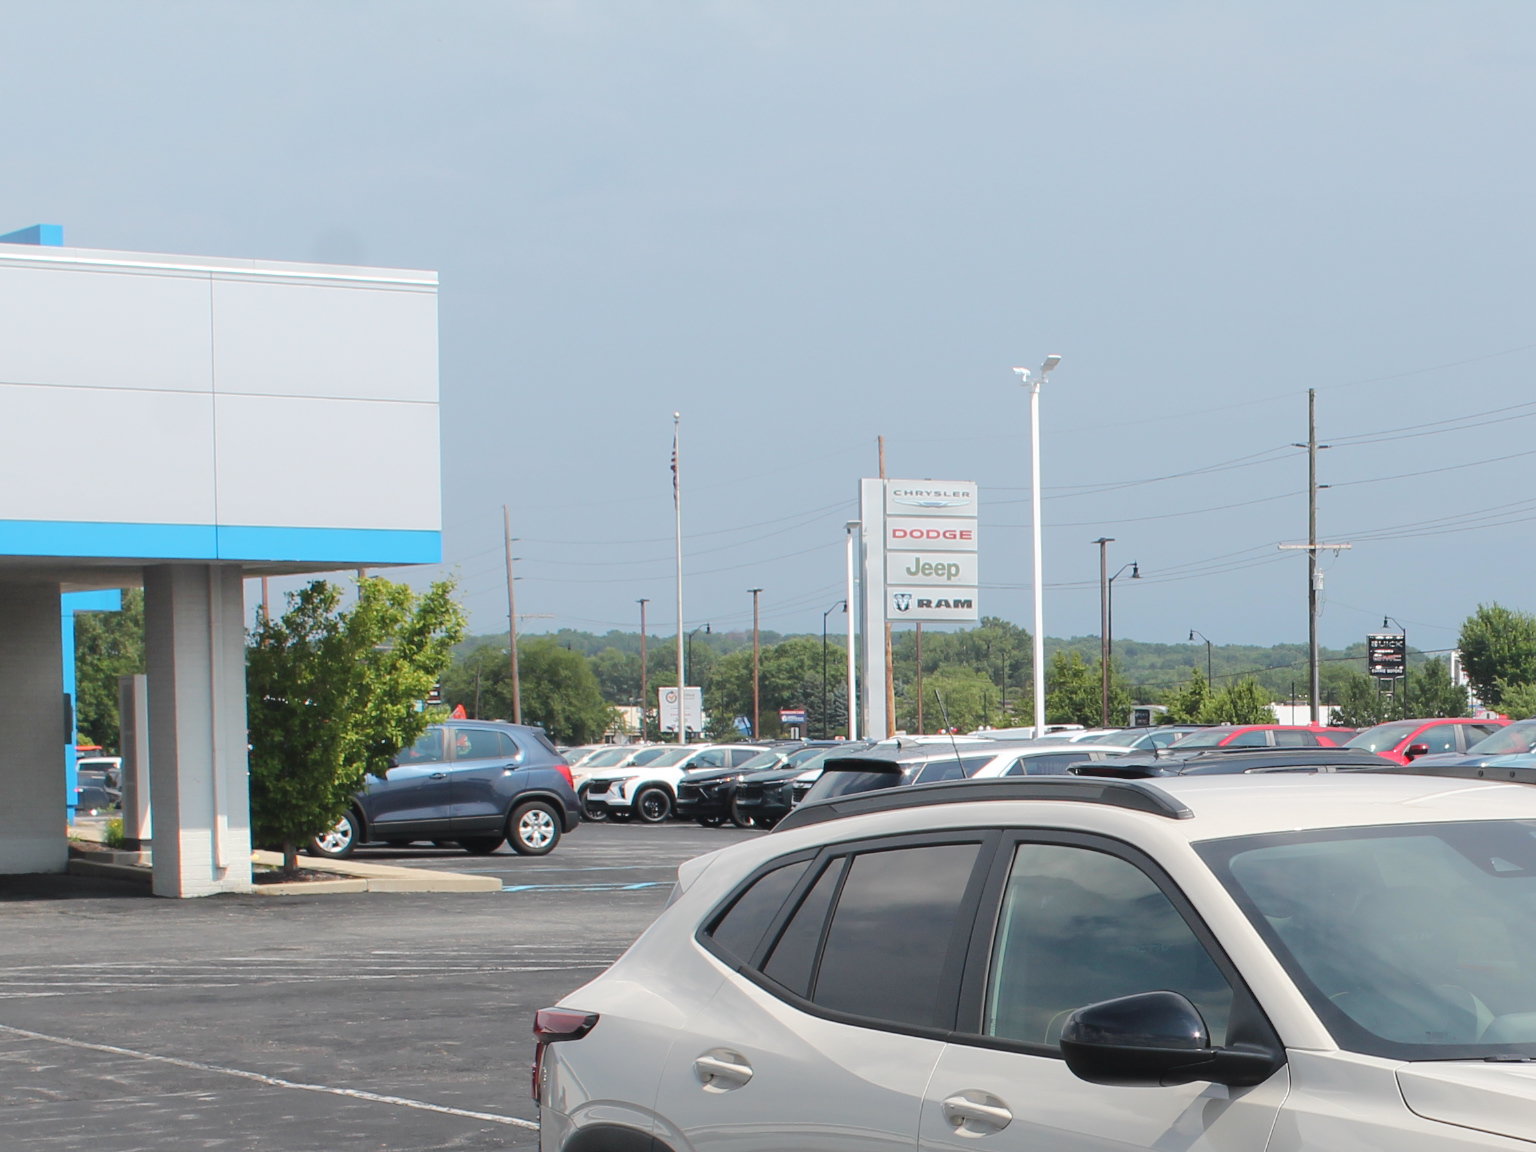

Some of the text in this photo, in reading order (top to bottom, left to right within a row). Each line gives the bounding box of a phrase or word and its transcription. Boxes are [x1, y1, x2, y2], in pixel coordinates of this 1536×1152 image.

[893, 489, 970, 498] CHRYSLER
[892, 528, 973, 540] DODGE
[905, 557, 960, 581] Jeep
[917, 598, 973, 609] RAM
[1371, 640, 1403, 648] BUICK
